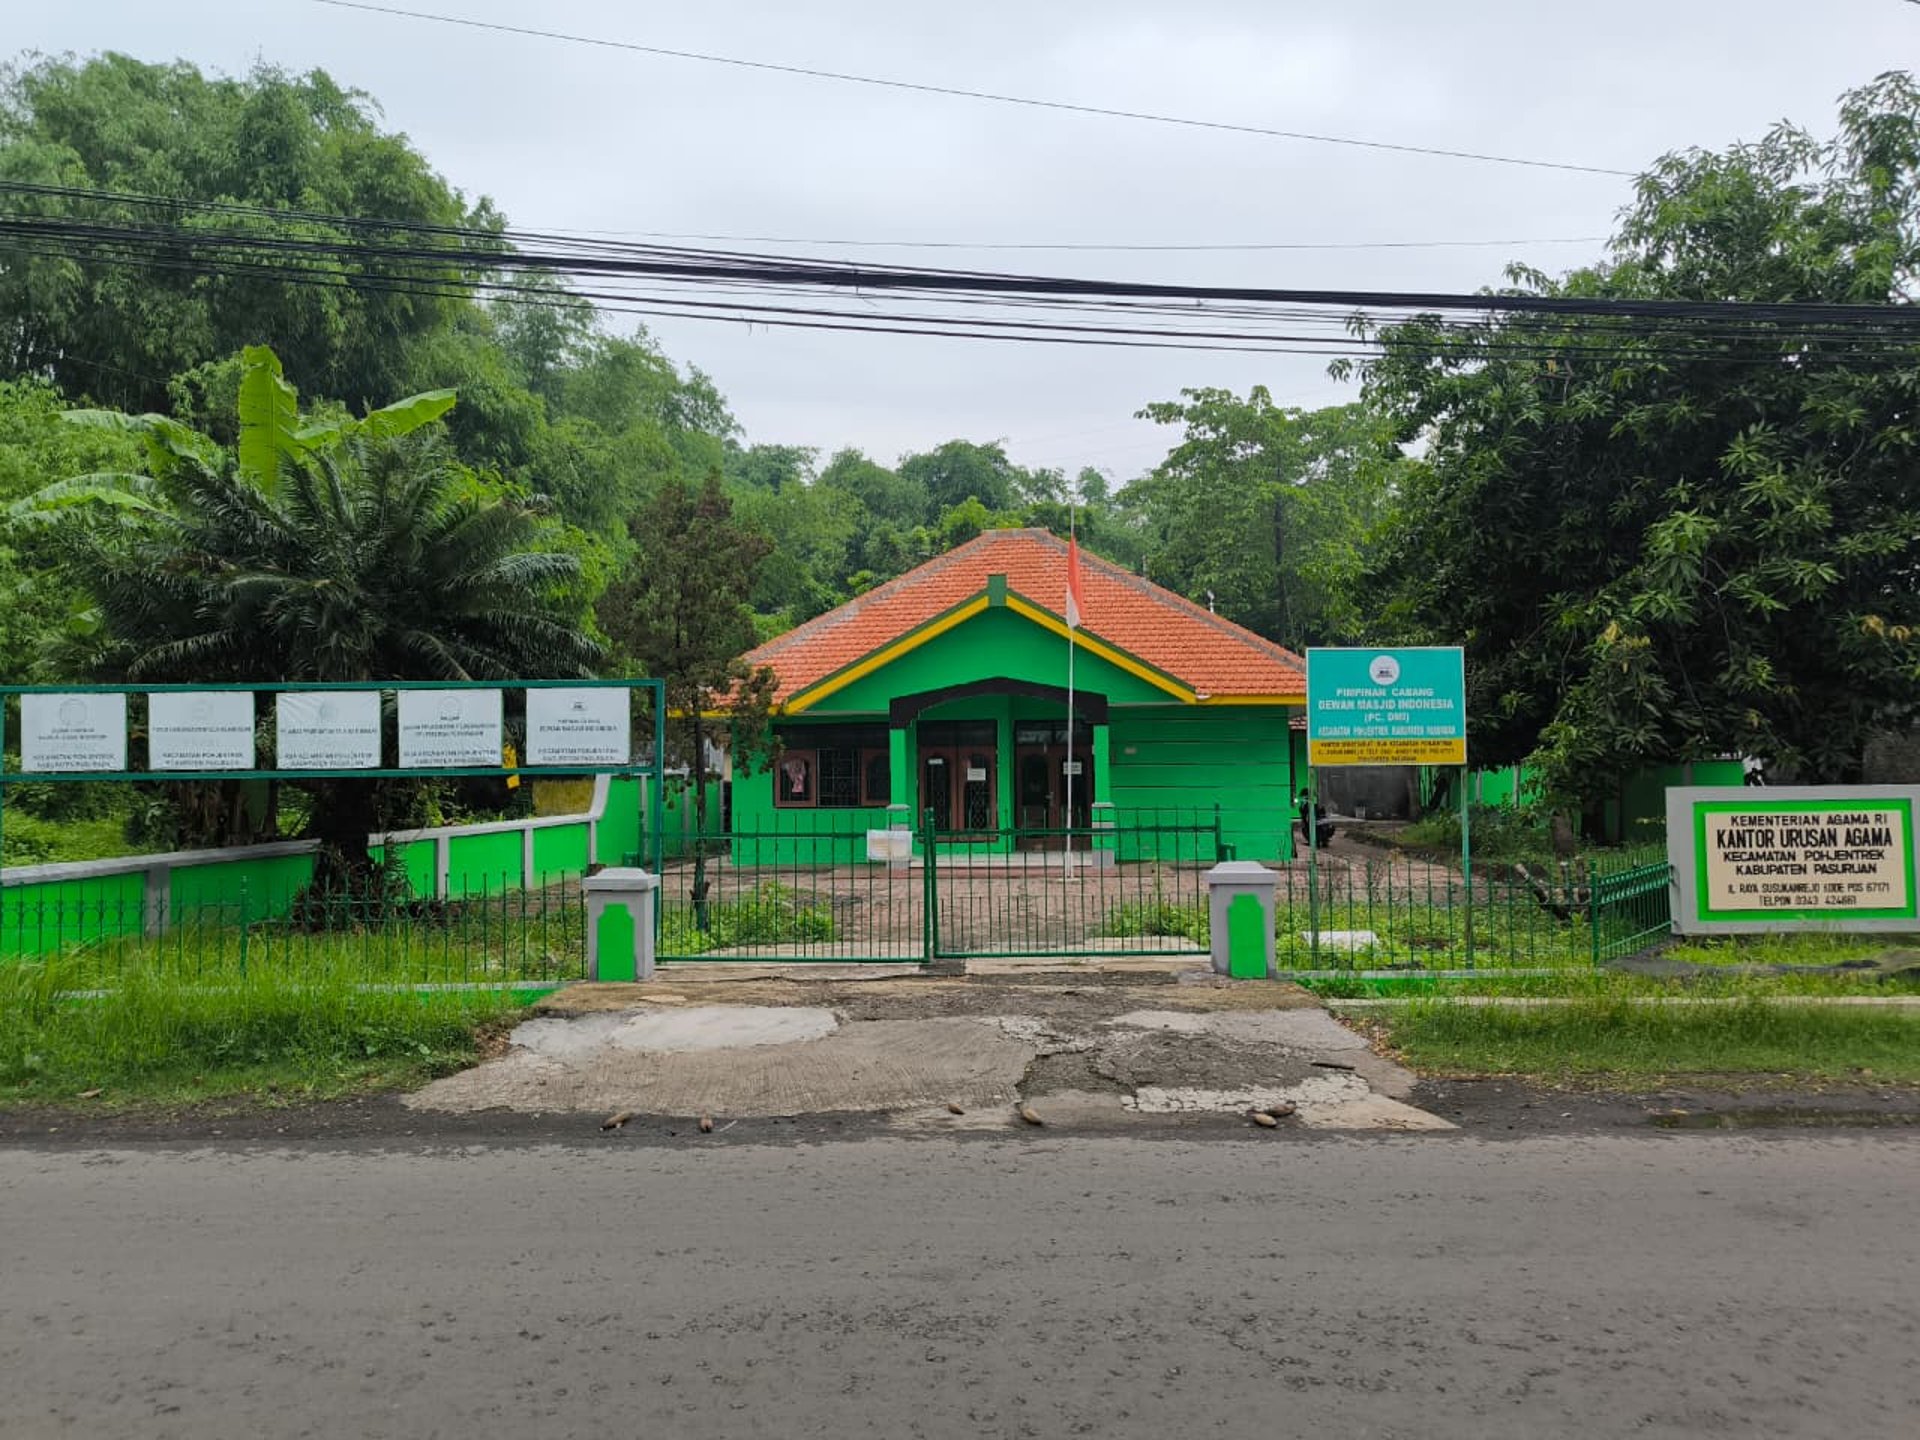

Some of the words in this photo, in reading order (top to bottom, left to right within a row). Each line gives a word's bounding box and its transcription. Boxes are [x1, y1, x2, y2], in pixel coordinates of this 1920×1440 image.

[1336, 688, 1386, 697] PIMPINAN
[1391, 688, 1434, 697] CABANG
[1318, 700, 1355, 710] DEWAN
[1357, 699, 1396, 710] MASJID
[1397, 699, 1454, 709] INDONESIA
[1730, 814, 1820, 826] KEMENTERIAN
[1826, 814, 1870, 825] AGAMA
[1874, 813, 1887, 824] RI
[1717, 829, 1775, 848] KANTOR
[1780, 828, 1837, 848] URUSAN
[1844, 827, 1893, 847] AGAMA
[1723, 851, 1796, 862] KECAMATAN
[1804, 850, 1885, 861] POHJENTREK
[1735, 864, 1807, 875] KABUPATEN
[1814, 863, 1877, 874] PASURUAN
